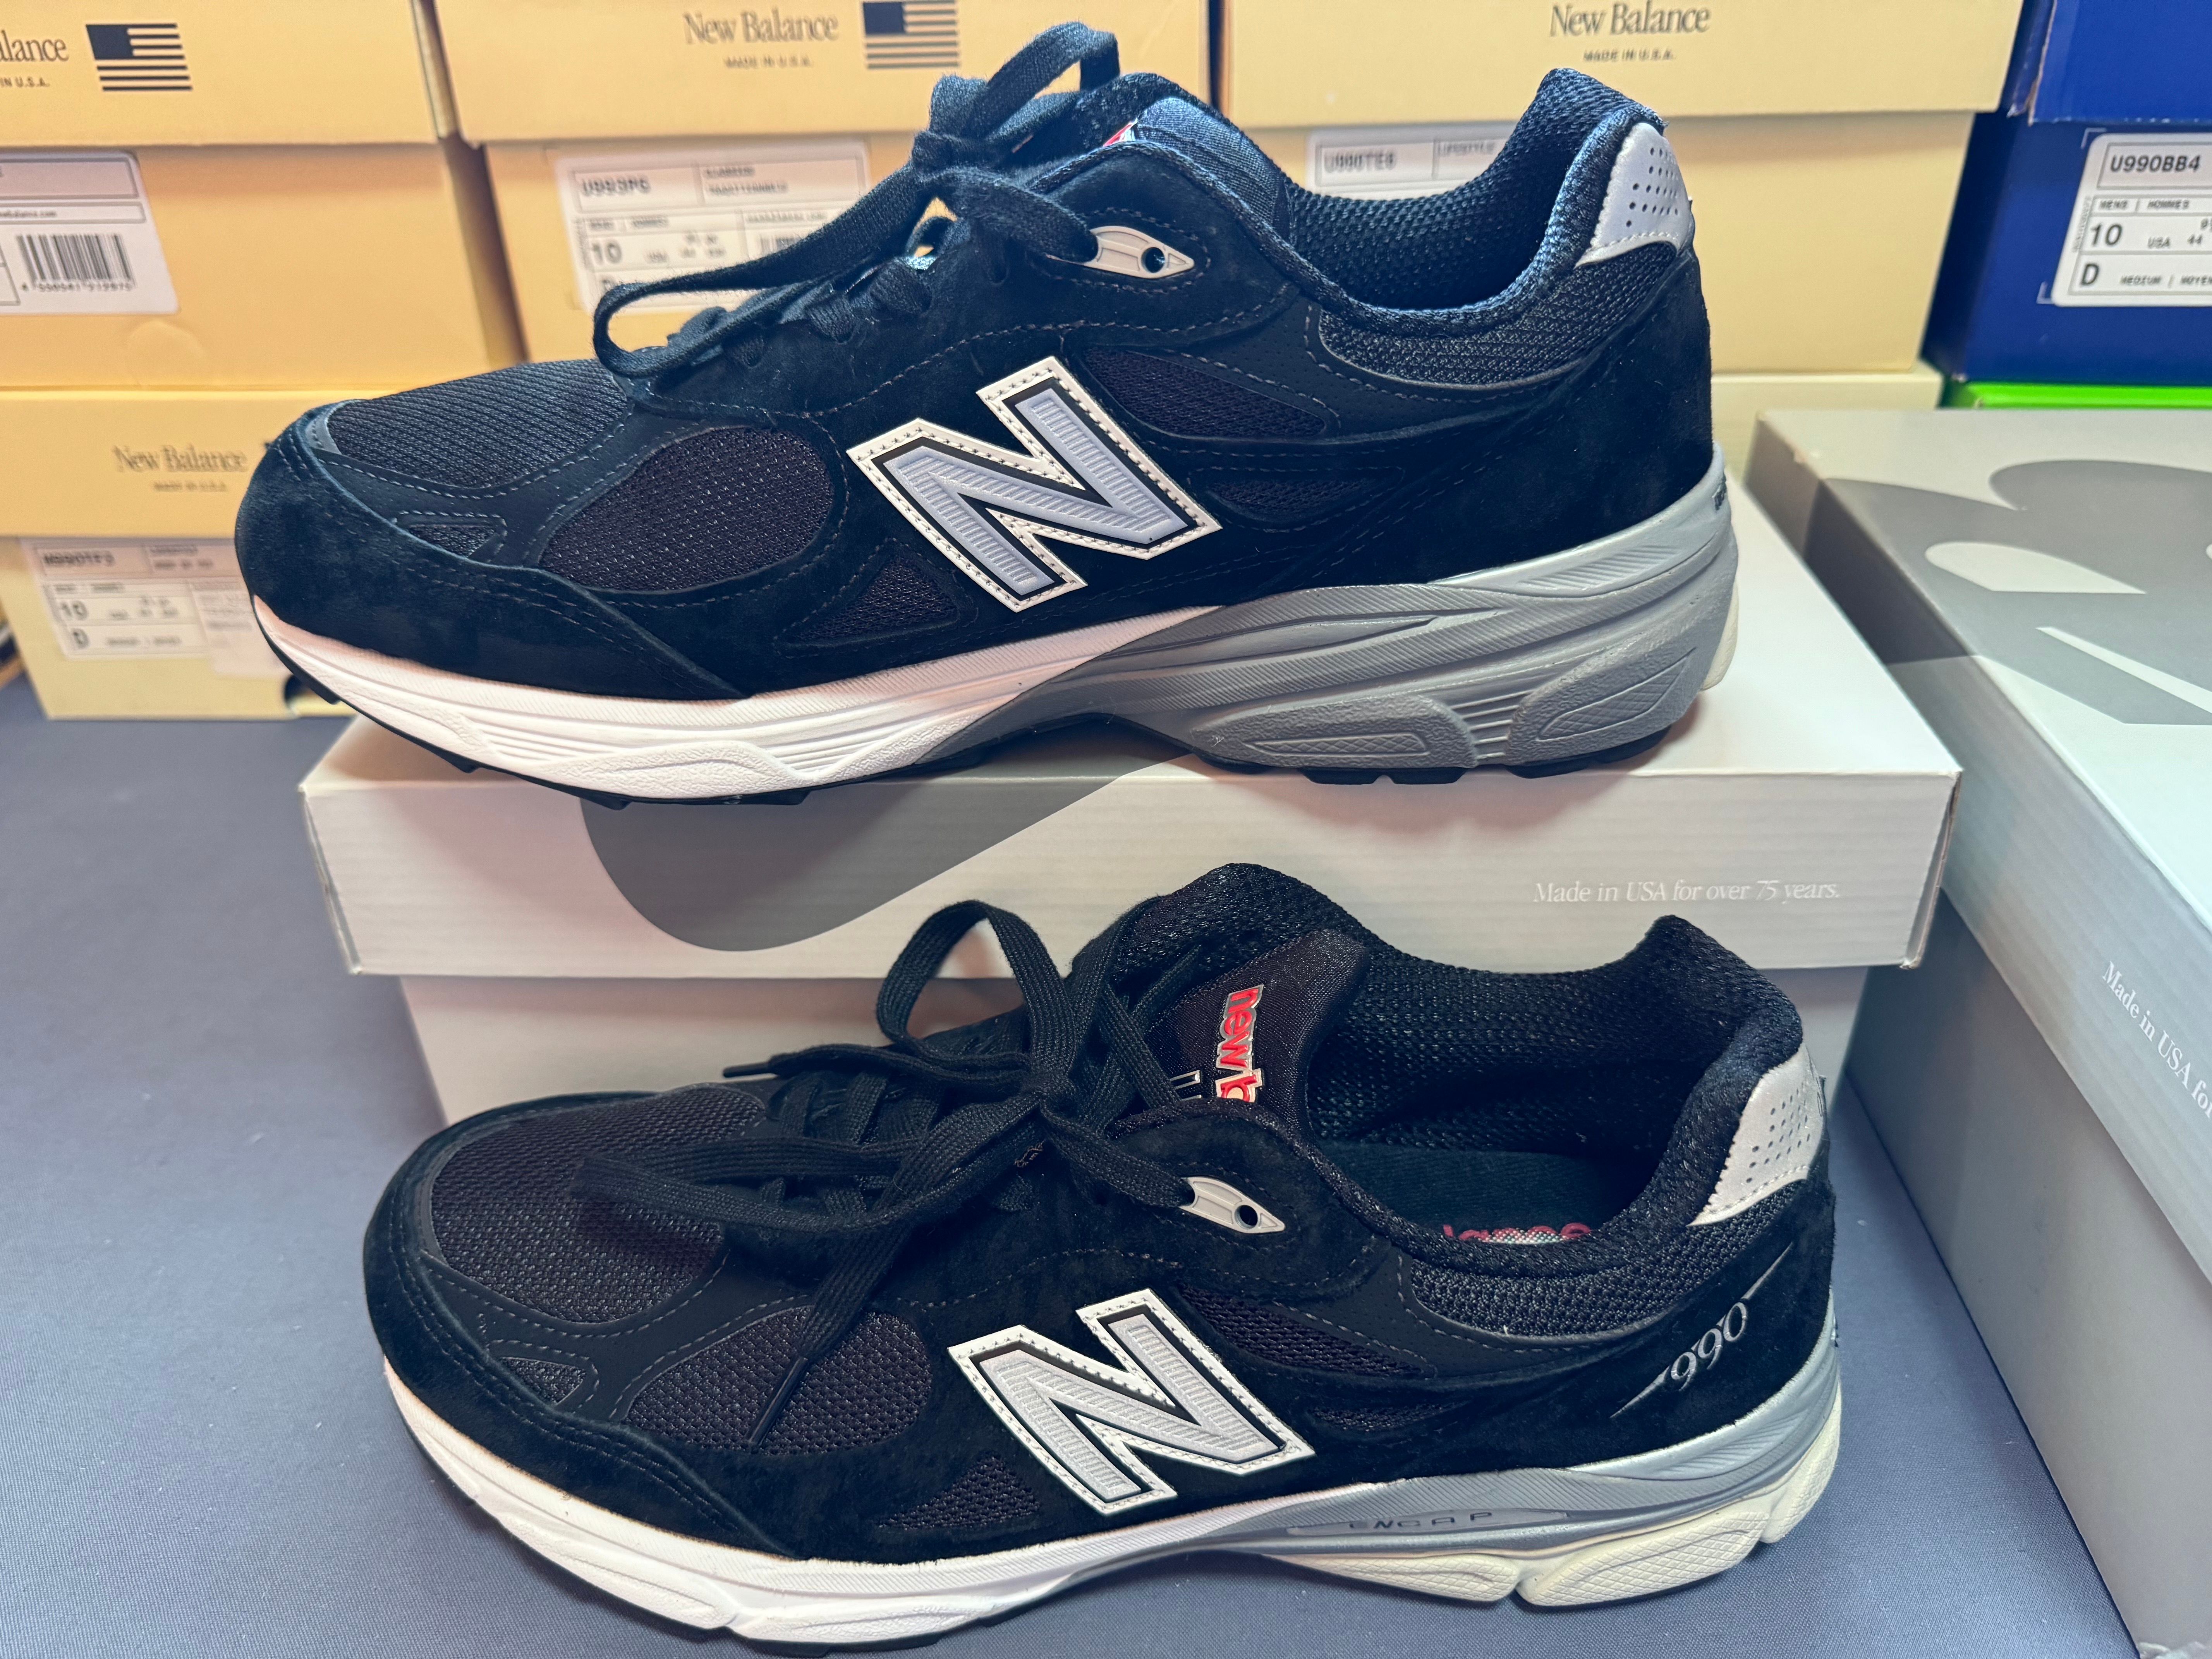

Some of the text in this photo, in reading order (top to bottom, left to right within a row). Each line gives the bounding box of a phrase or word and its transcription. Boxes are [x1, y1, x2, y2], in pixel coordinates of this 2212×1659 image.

[683, 6, 839, 45] New Balance
[1550, 0, 1711, 36] New Balance
[2111, 154, 2201, 172] U990BB4
[2091, 223, 2123, 247] 10
[591, 237, 623, 266] 10
[2080, 263, 2100, 286] D
[113, 441, 249, 473] New Balance
[60, 599, 89, 621] 10
[1534, 879, 1841, 905] Made in USA for over 75 years.
[2102, 960, 2139, 1019] Made
[2138, 1010, 2155, 1042] in
[2157, 1029, 2191, 1089] USA
[1670, 1301, 1748, 1393] 990
